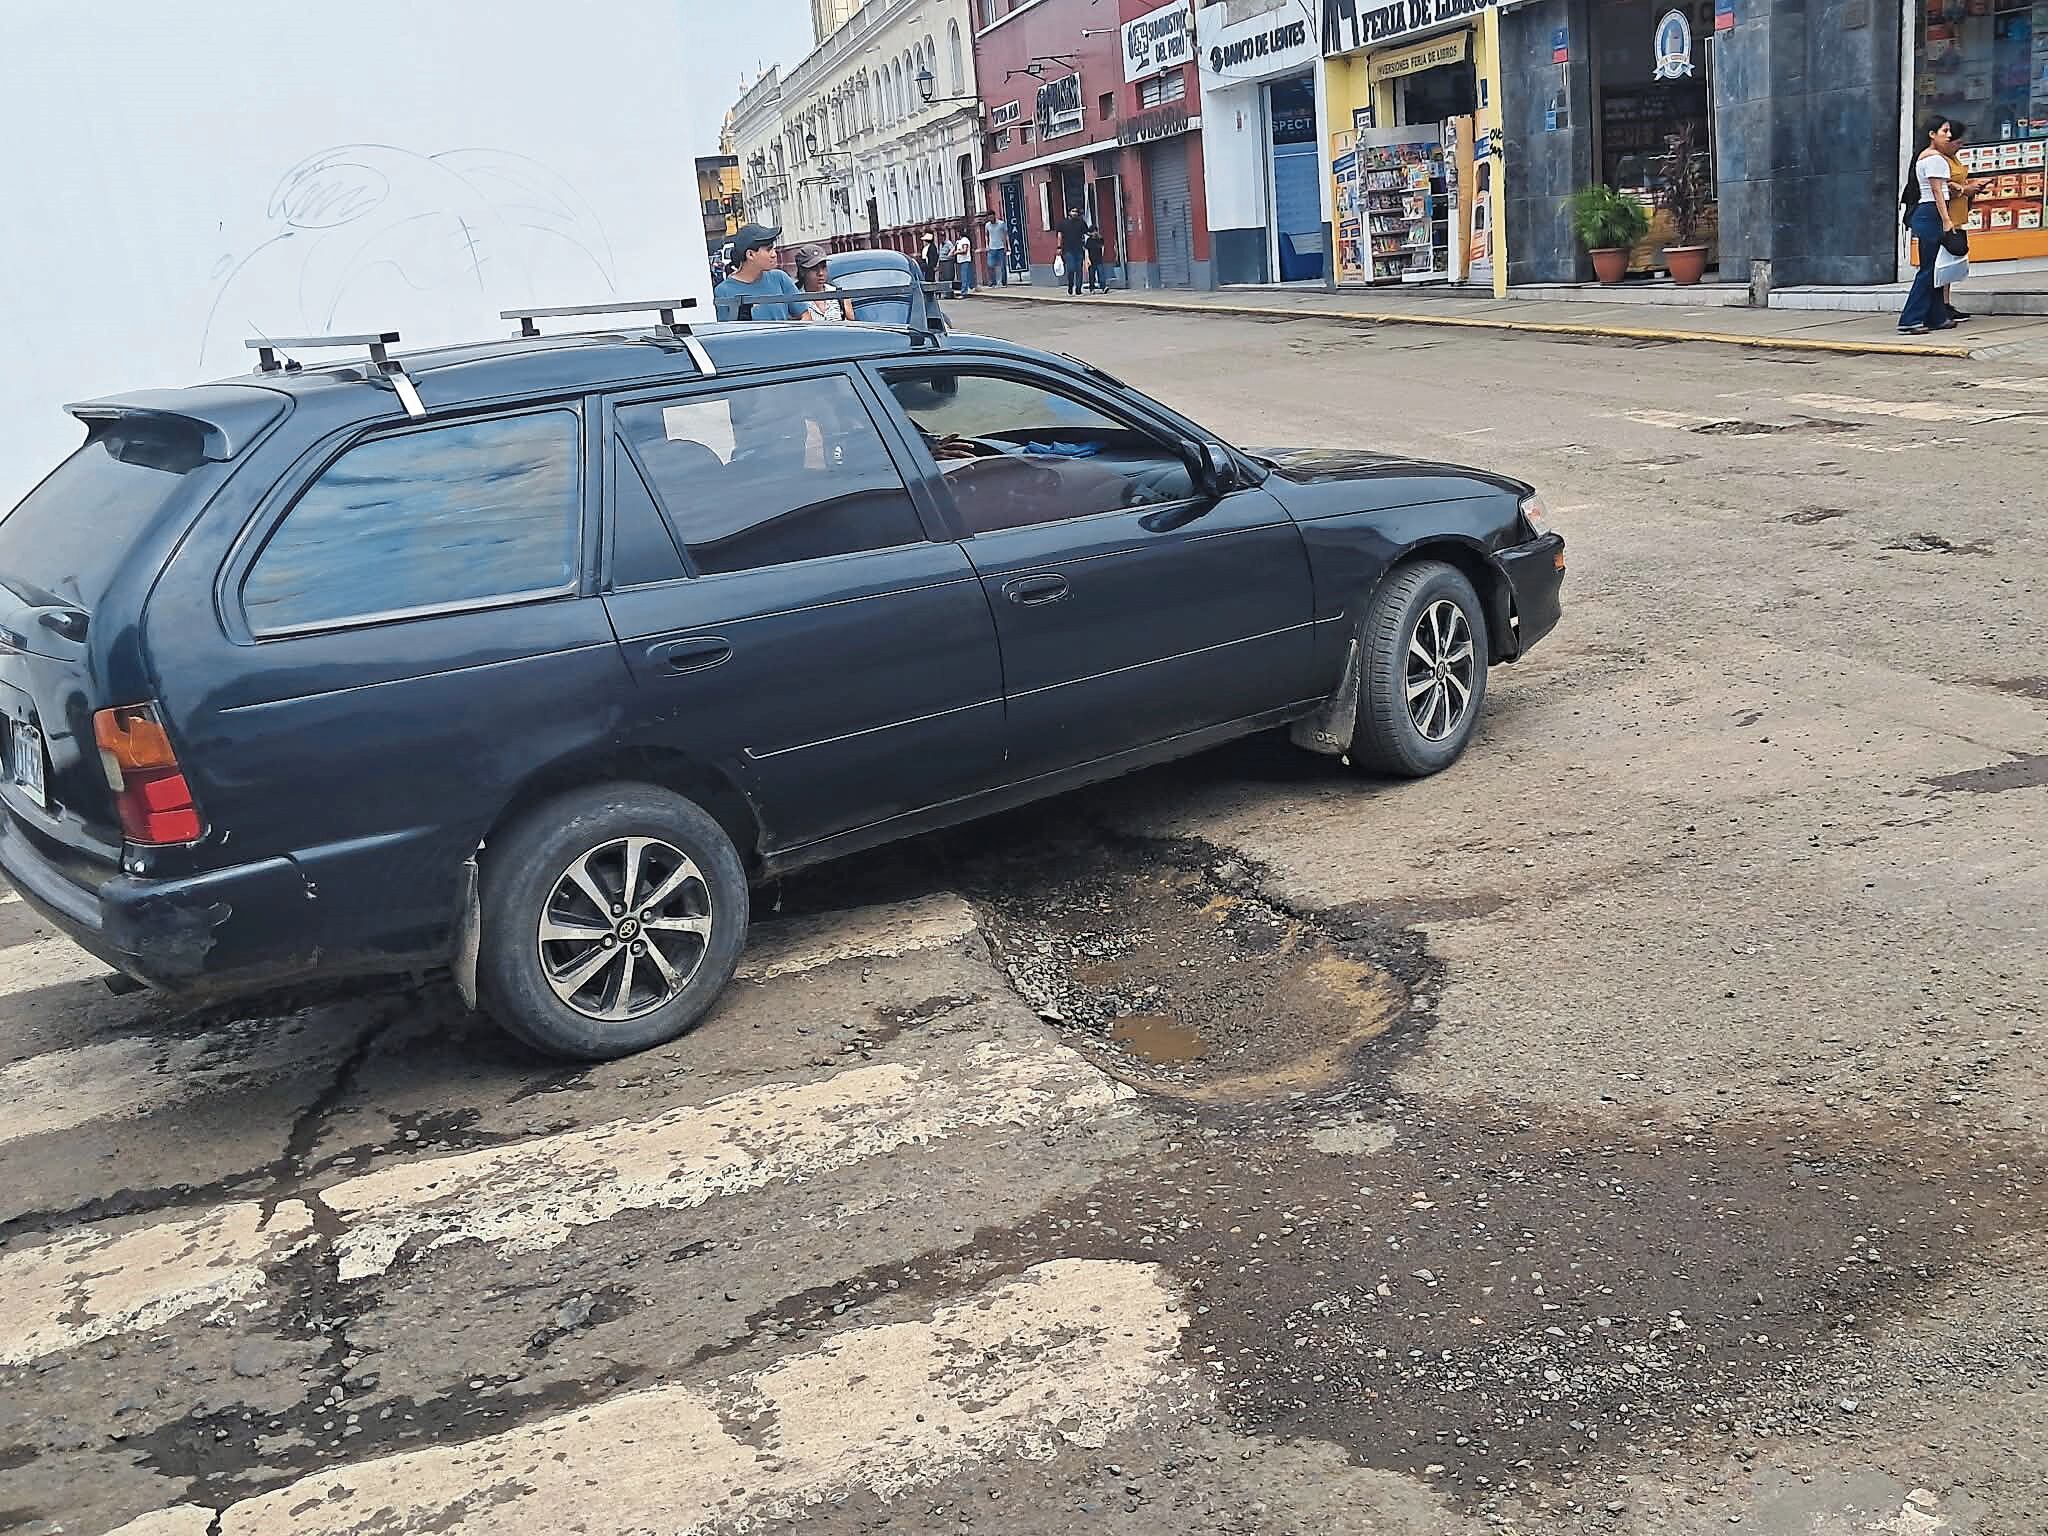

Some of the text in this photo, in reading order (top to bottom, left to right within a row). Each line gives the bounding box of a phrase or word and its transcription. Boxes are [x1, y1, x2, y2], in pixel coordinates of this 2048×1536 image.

[1361, 2, 1407, 42] FERIA
[1408, 0, 1431, 29] DE
[1155, 42, 1167, 63] DEL
[1223, 20, 1305, 67] BANCO DE LENTES
[1410, 55, 1427, 68] FERIA
[1427, 50, 1436, 62] DE
[1436, 45, 1457, 60] LIBROS
[1013, 239, 1022, 269] ALVA
